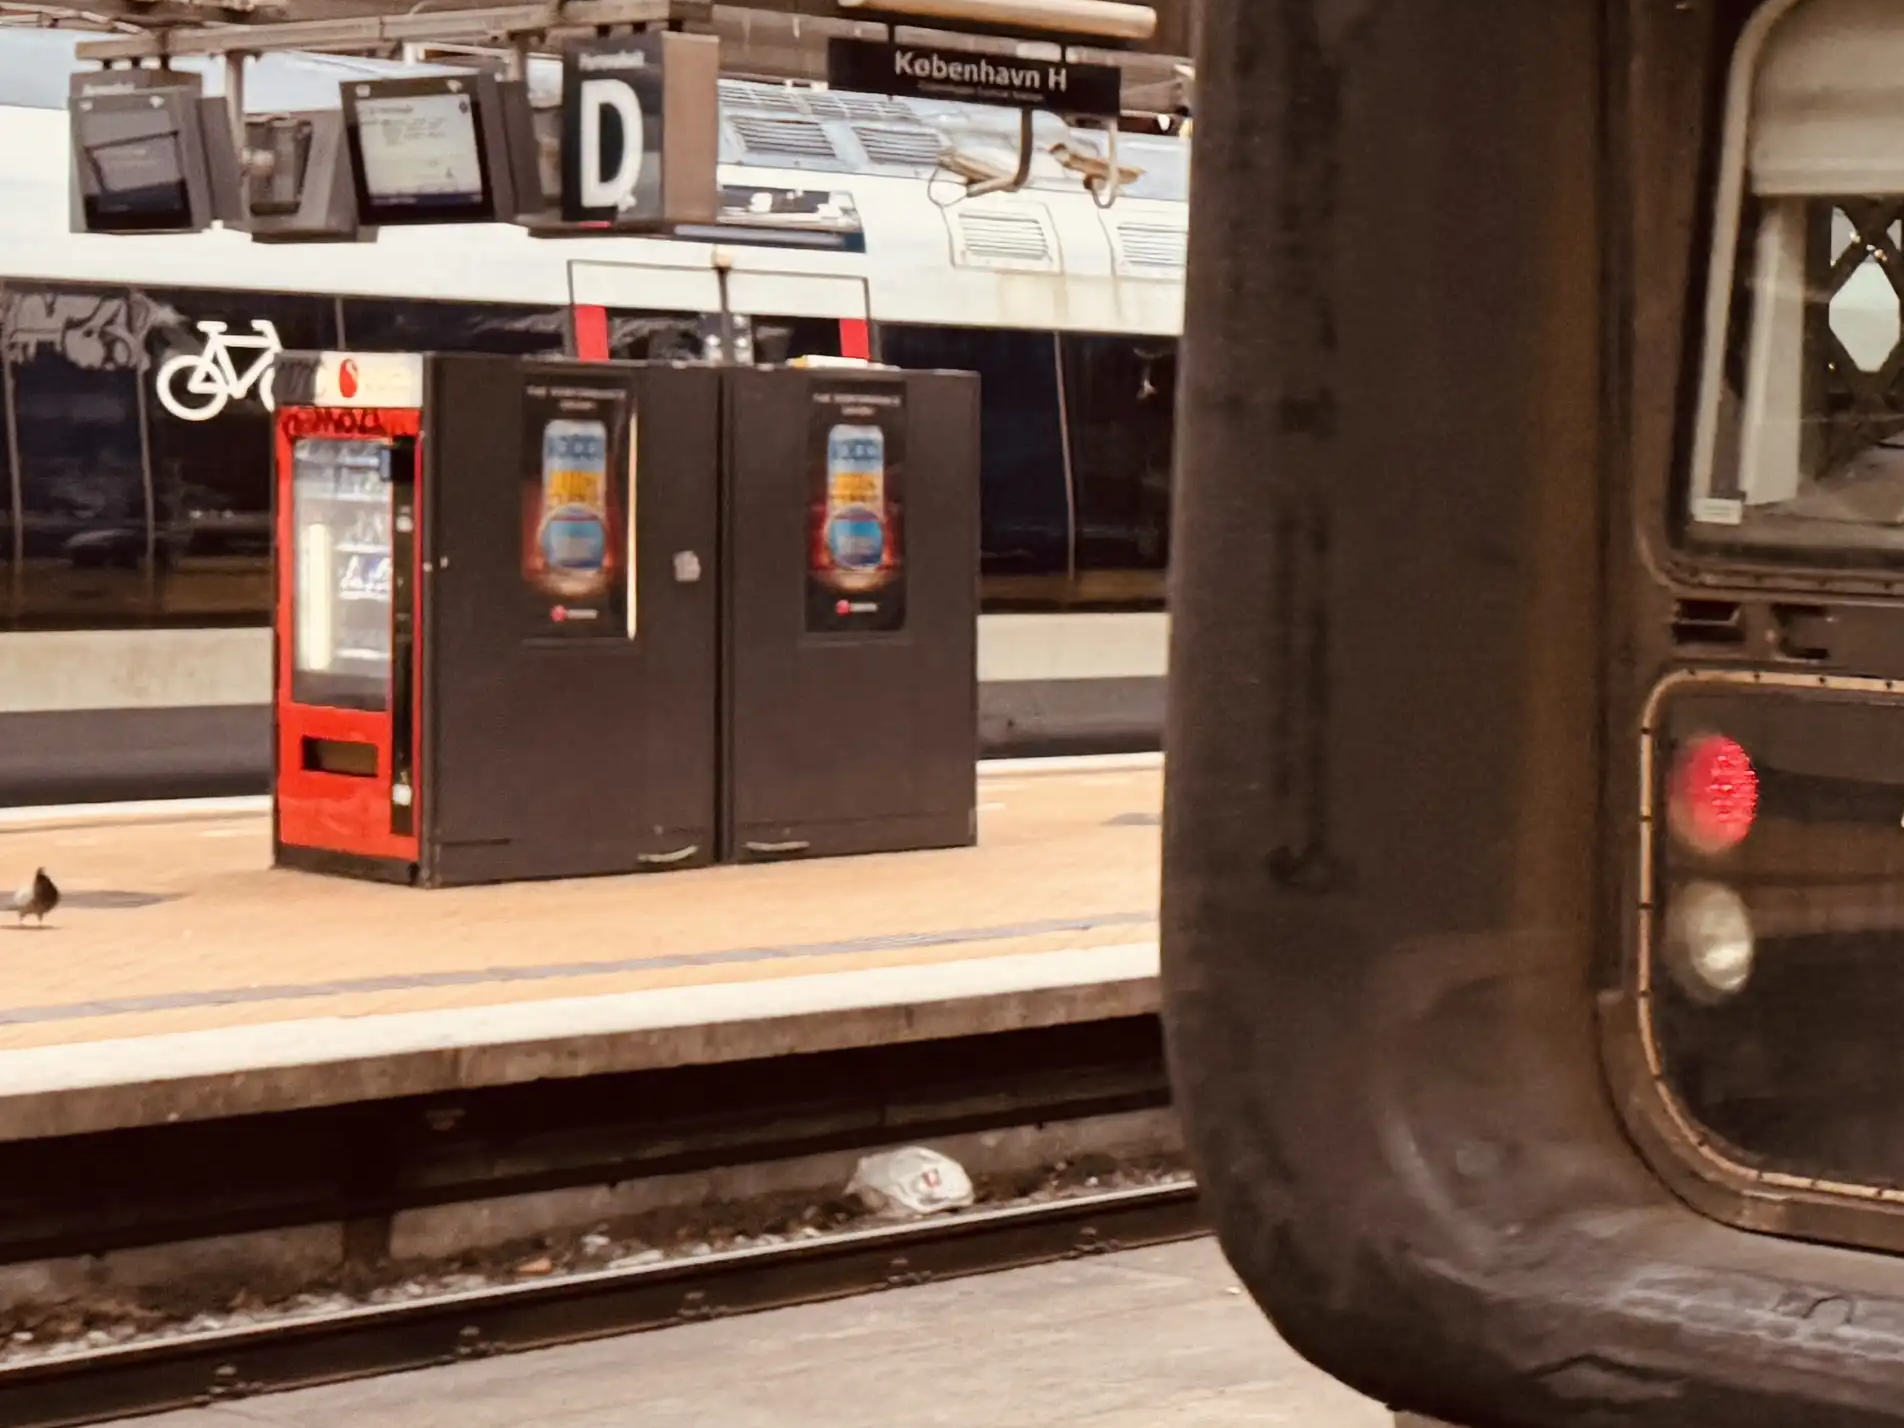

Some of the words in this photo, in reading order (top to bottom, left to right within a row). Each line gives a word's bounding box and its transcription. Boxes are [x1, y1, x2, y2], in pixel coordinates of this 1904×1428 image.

[894, 50, 1041, 89] København
[1048, 66, 1068, 93] H
[580, 78, 644, 209] D
